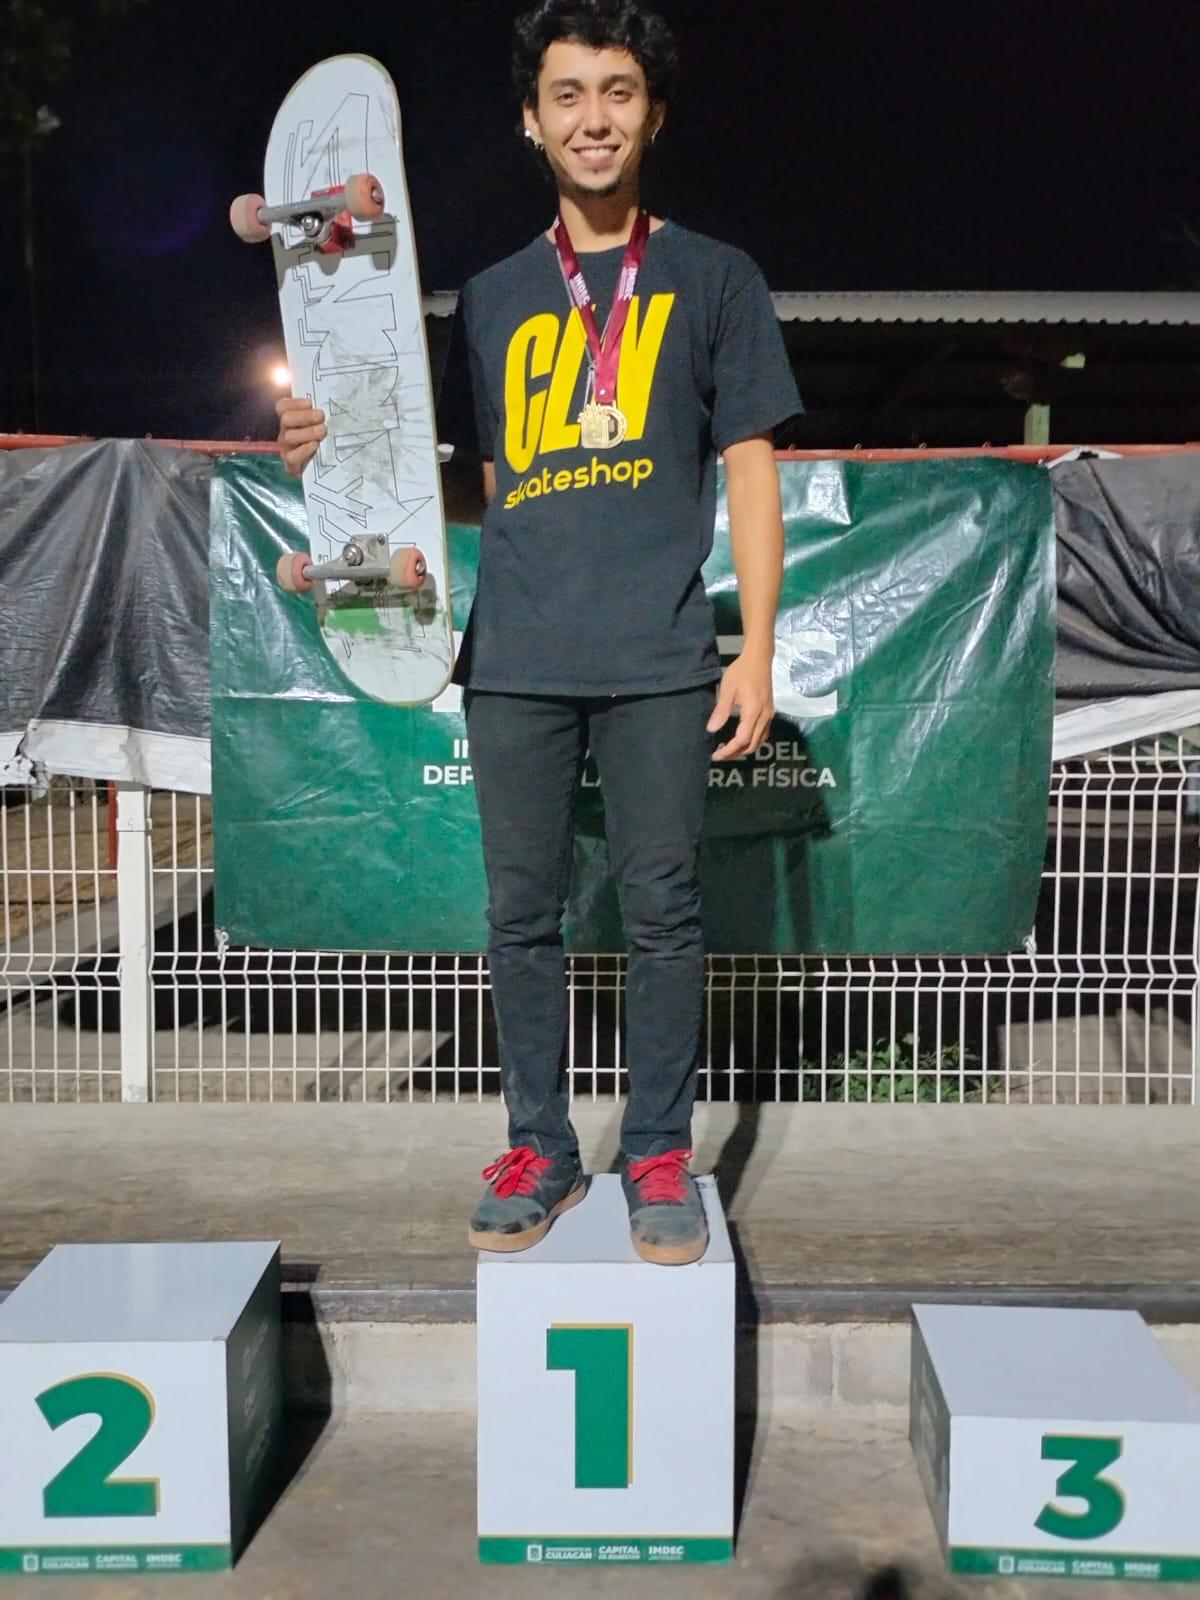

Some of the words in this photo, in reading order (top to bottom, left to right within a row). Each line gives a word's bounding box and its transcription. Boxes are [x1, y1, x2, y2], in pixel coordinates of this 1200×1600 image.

[504, 456, 653, 510] skateshop
[755, 741, 807, 761] DEL
[752, 763, 837, 788] FÍSICA
[546, 1323, 633, 1488] 1
[35, 1372, 160, 1517] 2
[1034, 1432, 1126, 1540] 3
[96, 1554, 137, 1563] CAPITAL
[598, 1546, 640, 1554] CAPITAL
[649, 1546, 684, 1555] IMDEC
